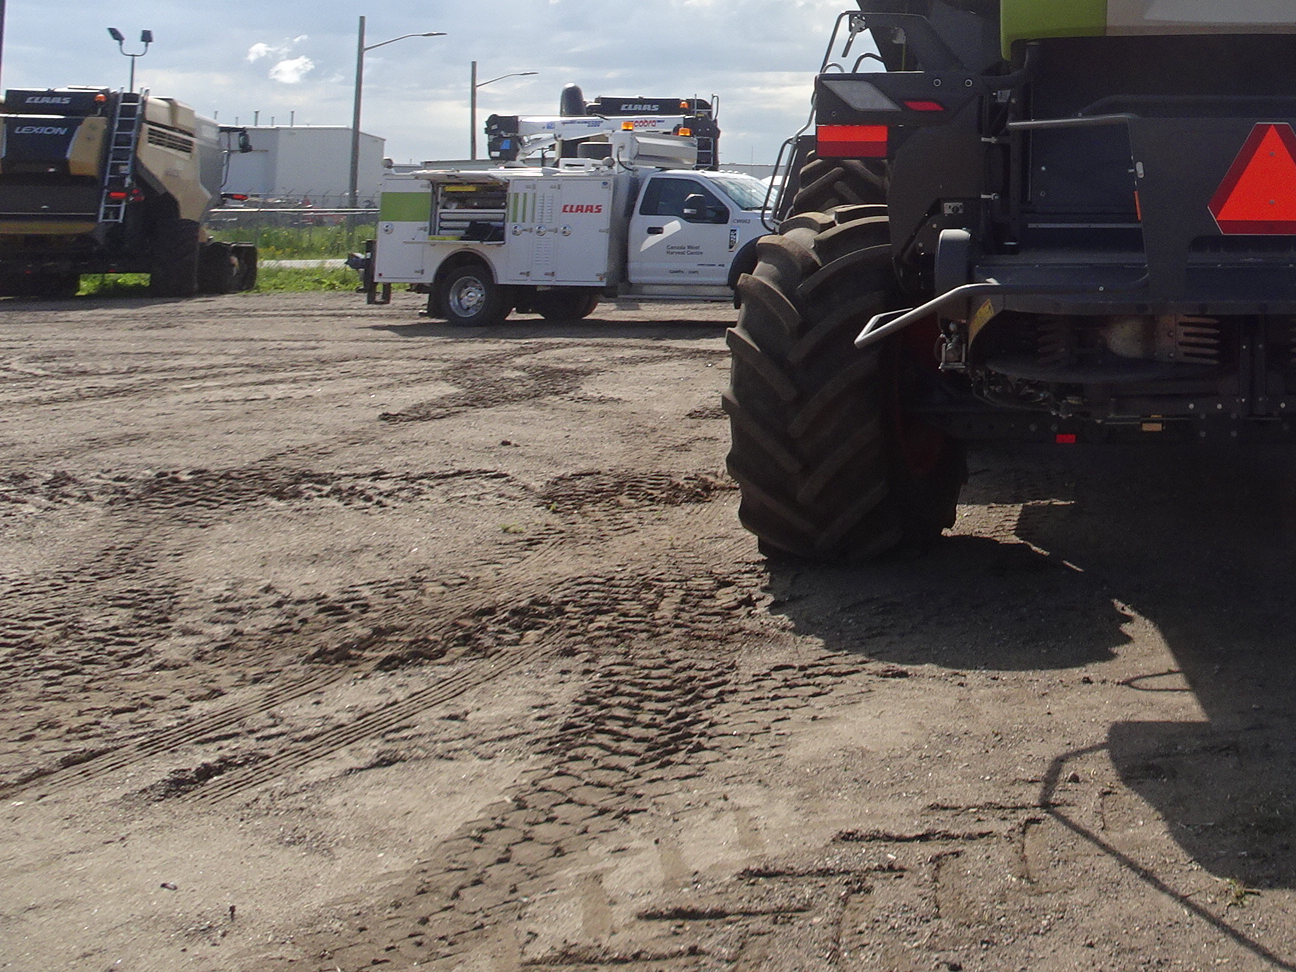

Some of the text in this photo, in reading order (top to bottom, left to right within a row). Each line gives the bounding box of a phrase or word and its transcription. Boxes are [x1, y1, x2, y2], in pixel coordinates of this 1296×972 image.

[25, 96, 72, 104] CLAAS
[14, 126, 68, 135] LEXION
[562, 204, 603, 213] CLAAS
